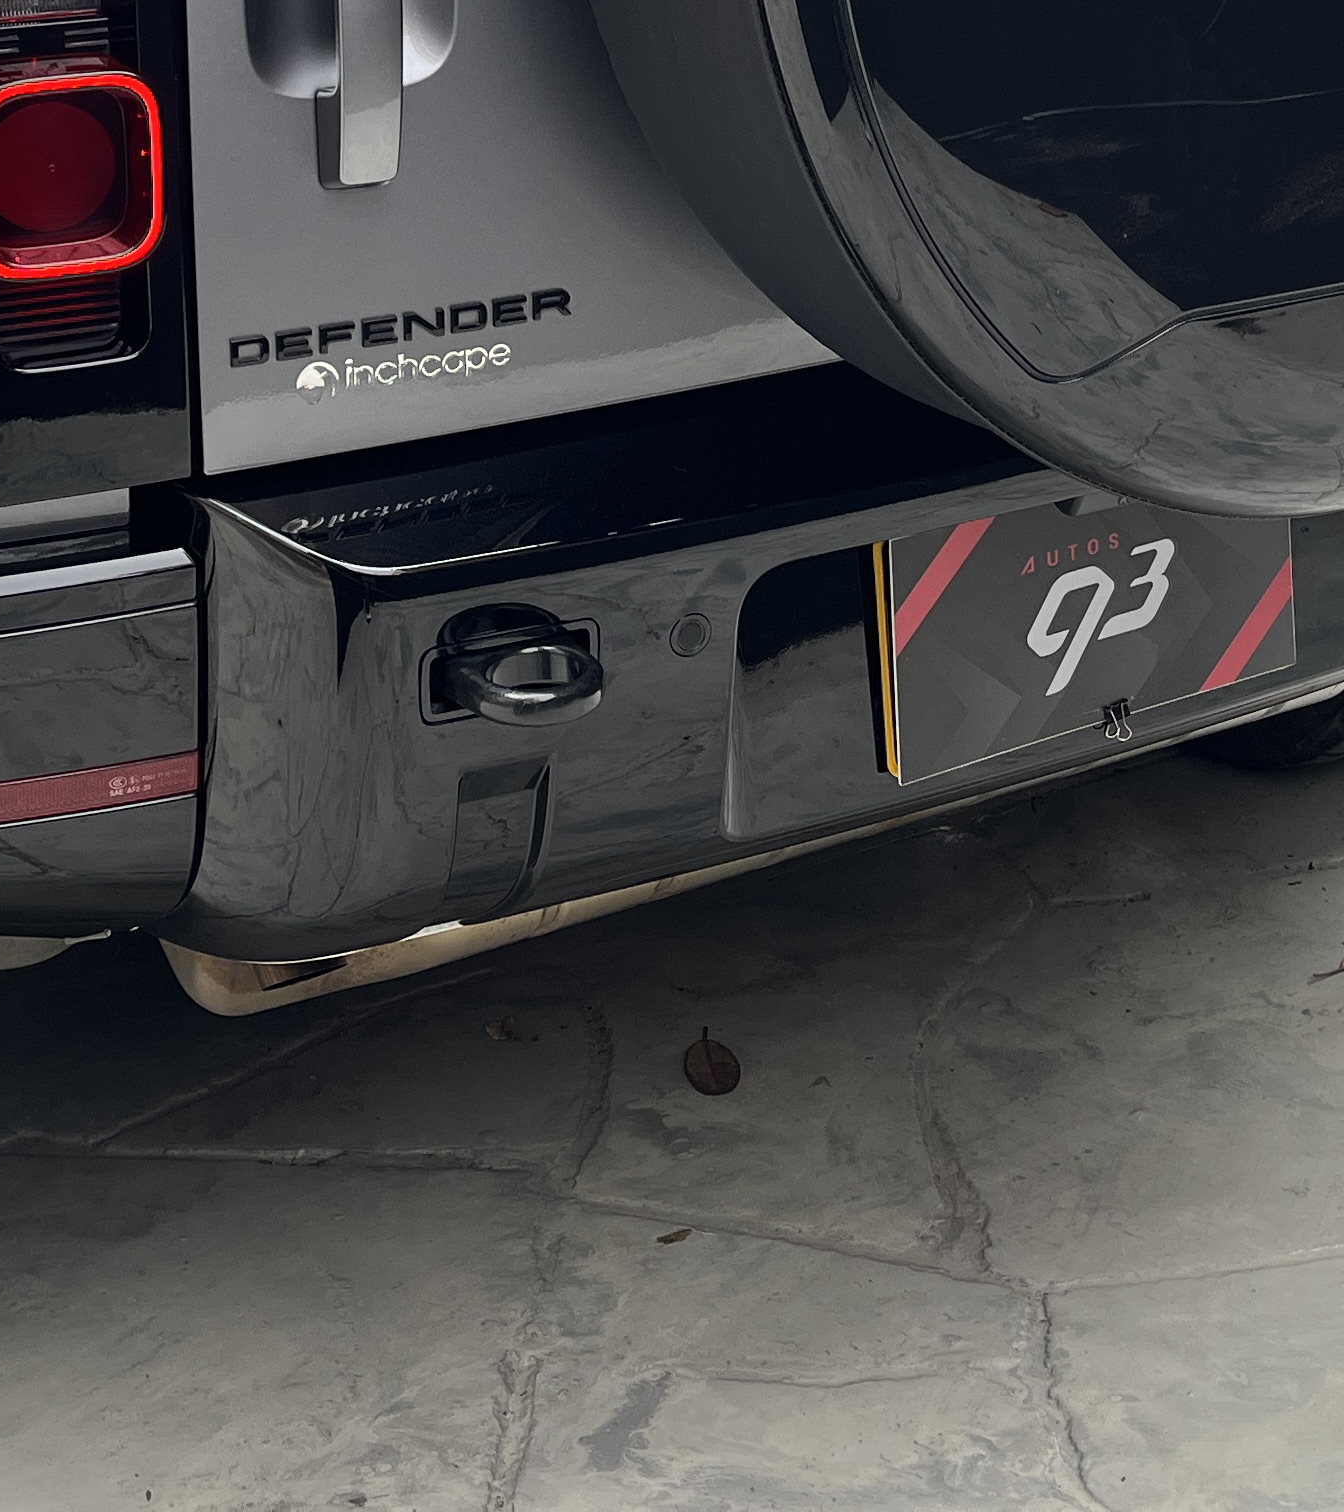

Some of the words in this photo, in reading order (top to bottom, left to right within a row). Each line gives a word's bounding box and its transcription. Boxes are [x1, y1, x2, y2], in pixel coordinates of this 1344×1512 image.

[229, 288, 572, 368] DEFENDER
[345, 342, 512, 388] inchcape
[1021, 533, 1120, 575] AUTOS
